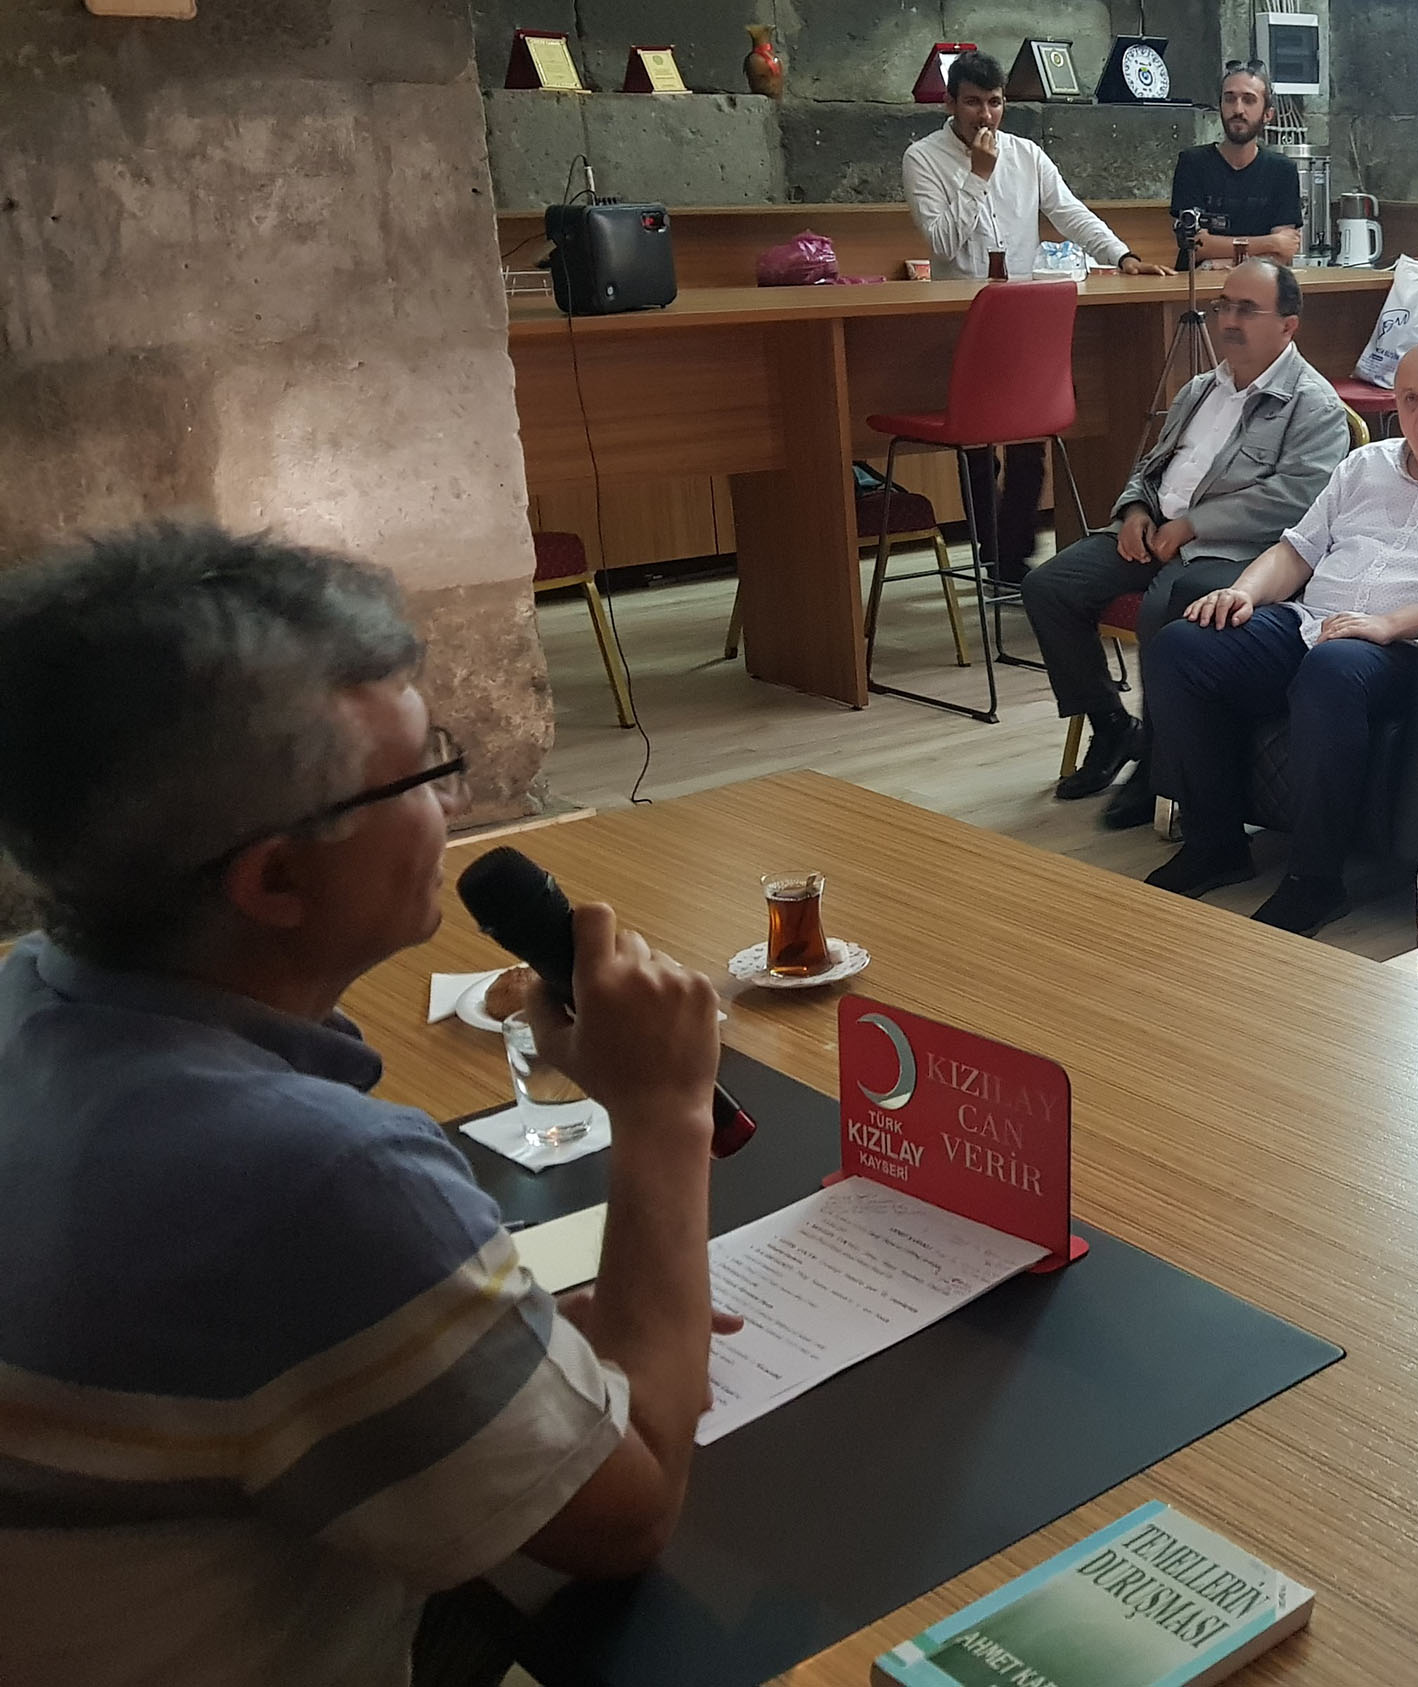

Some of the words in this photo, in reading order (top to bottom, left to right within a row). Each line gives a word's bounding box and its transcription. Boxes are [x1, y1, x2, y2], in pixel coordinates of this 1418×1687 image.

[926, 1052, 1057, 1122] KIZILAY
[847, 1118, 925, 1168] KIZILAY
[868, 1110, 903, 1135] TÜRK
[958, 1103, 1025, 1150] CAN
[940, 1132, 1043, 1197] VERİR
[1076, 1548, 1231, 1649] DURUŞMASI
[1121, 1523, 1270, 1619] TEMELLERİN
[955, 1631, 1025, 1675] AHMET
